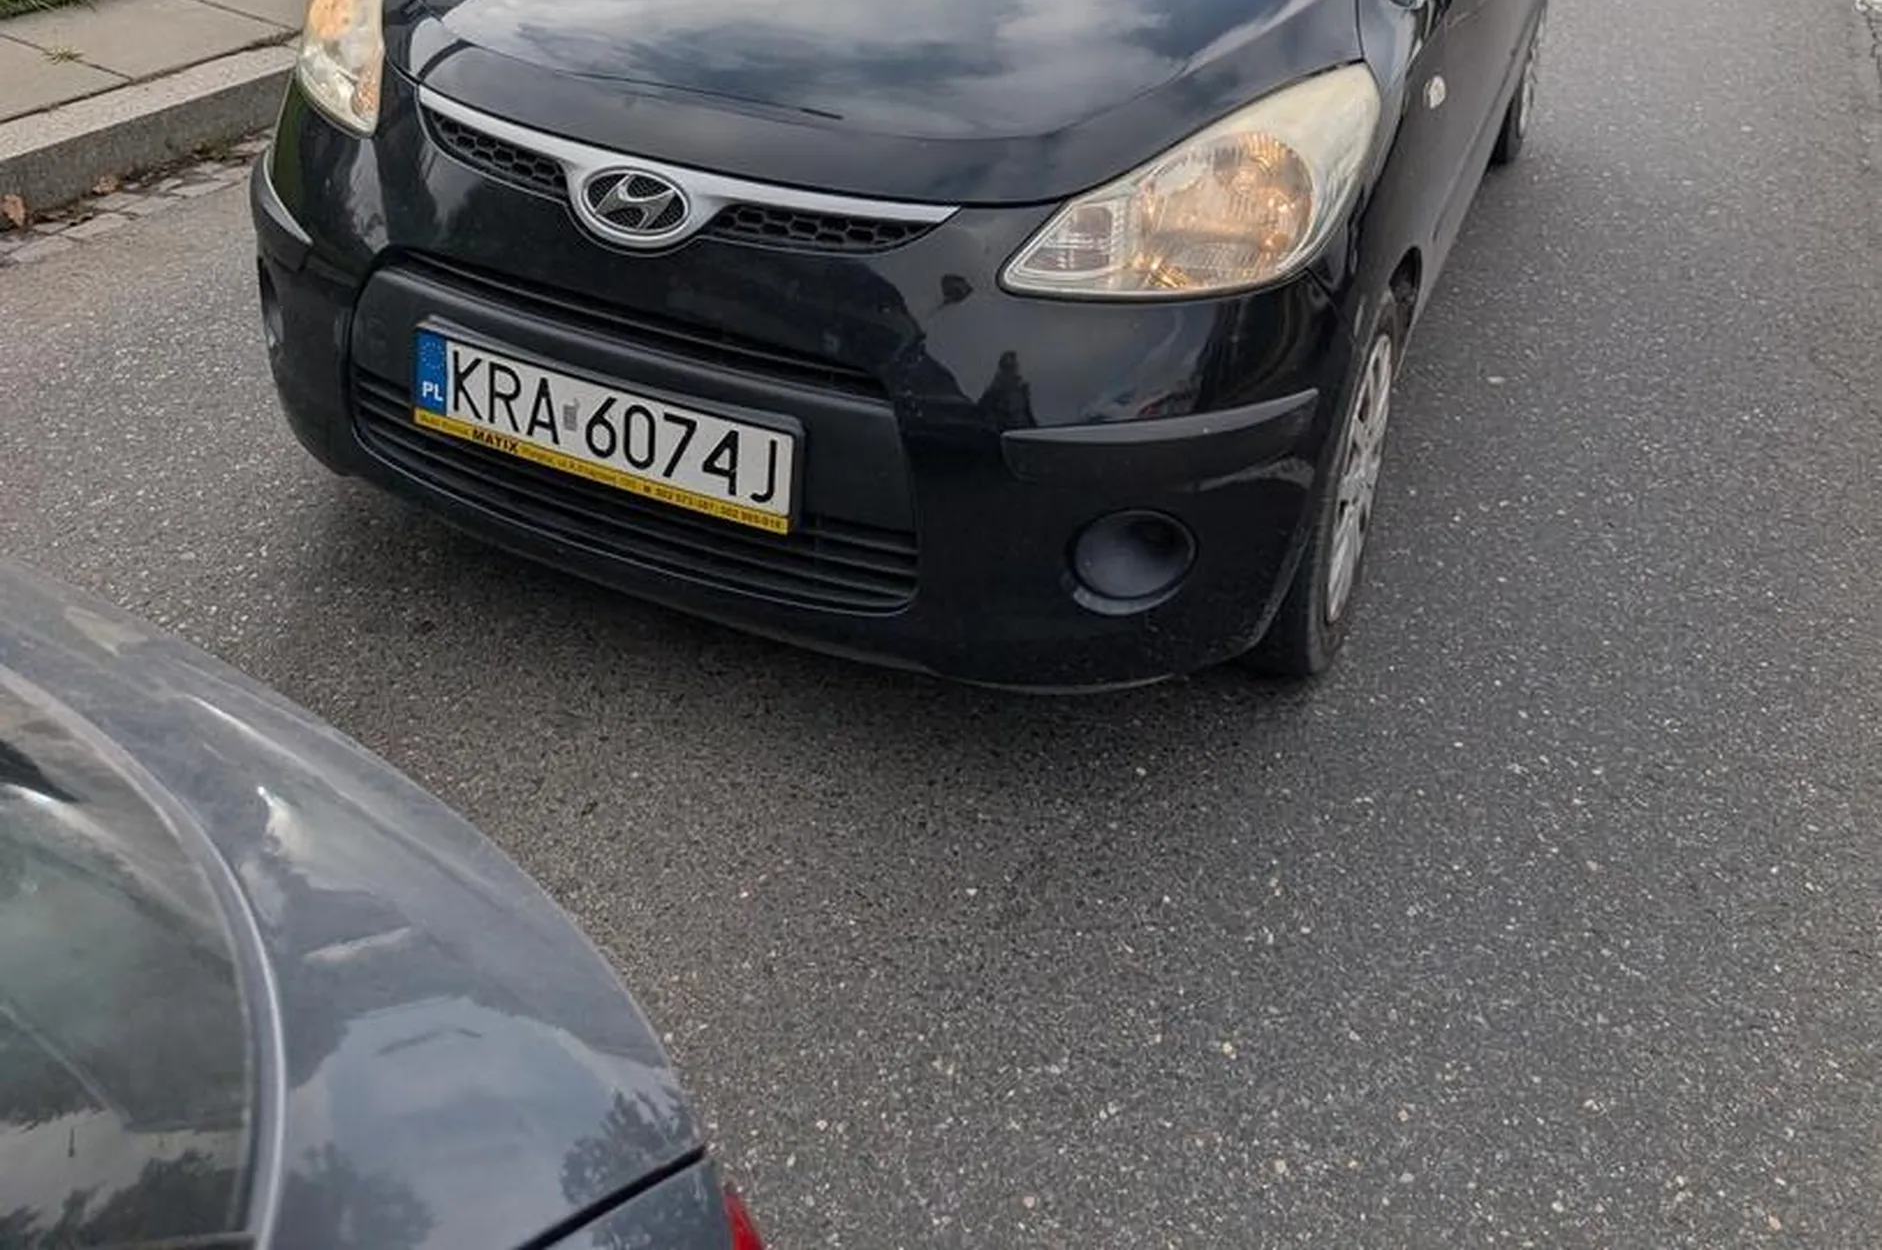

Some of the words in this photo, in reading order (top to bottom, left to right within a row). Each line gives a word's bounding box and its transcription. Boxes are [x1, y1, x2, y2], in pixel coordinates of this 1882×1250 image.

[421, 381, 444, 403] PL
[453, 350, 560, 445] KRA
[585, 397, 779, 504] 6074J
